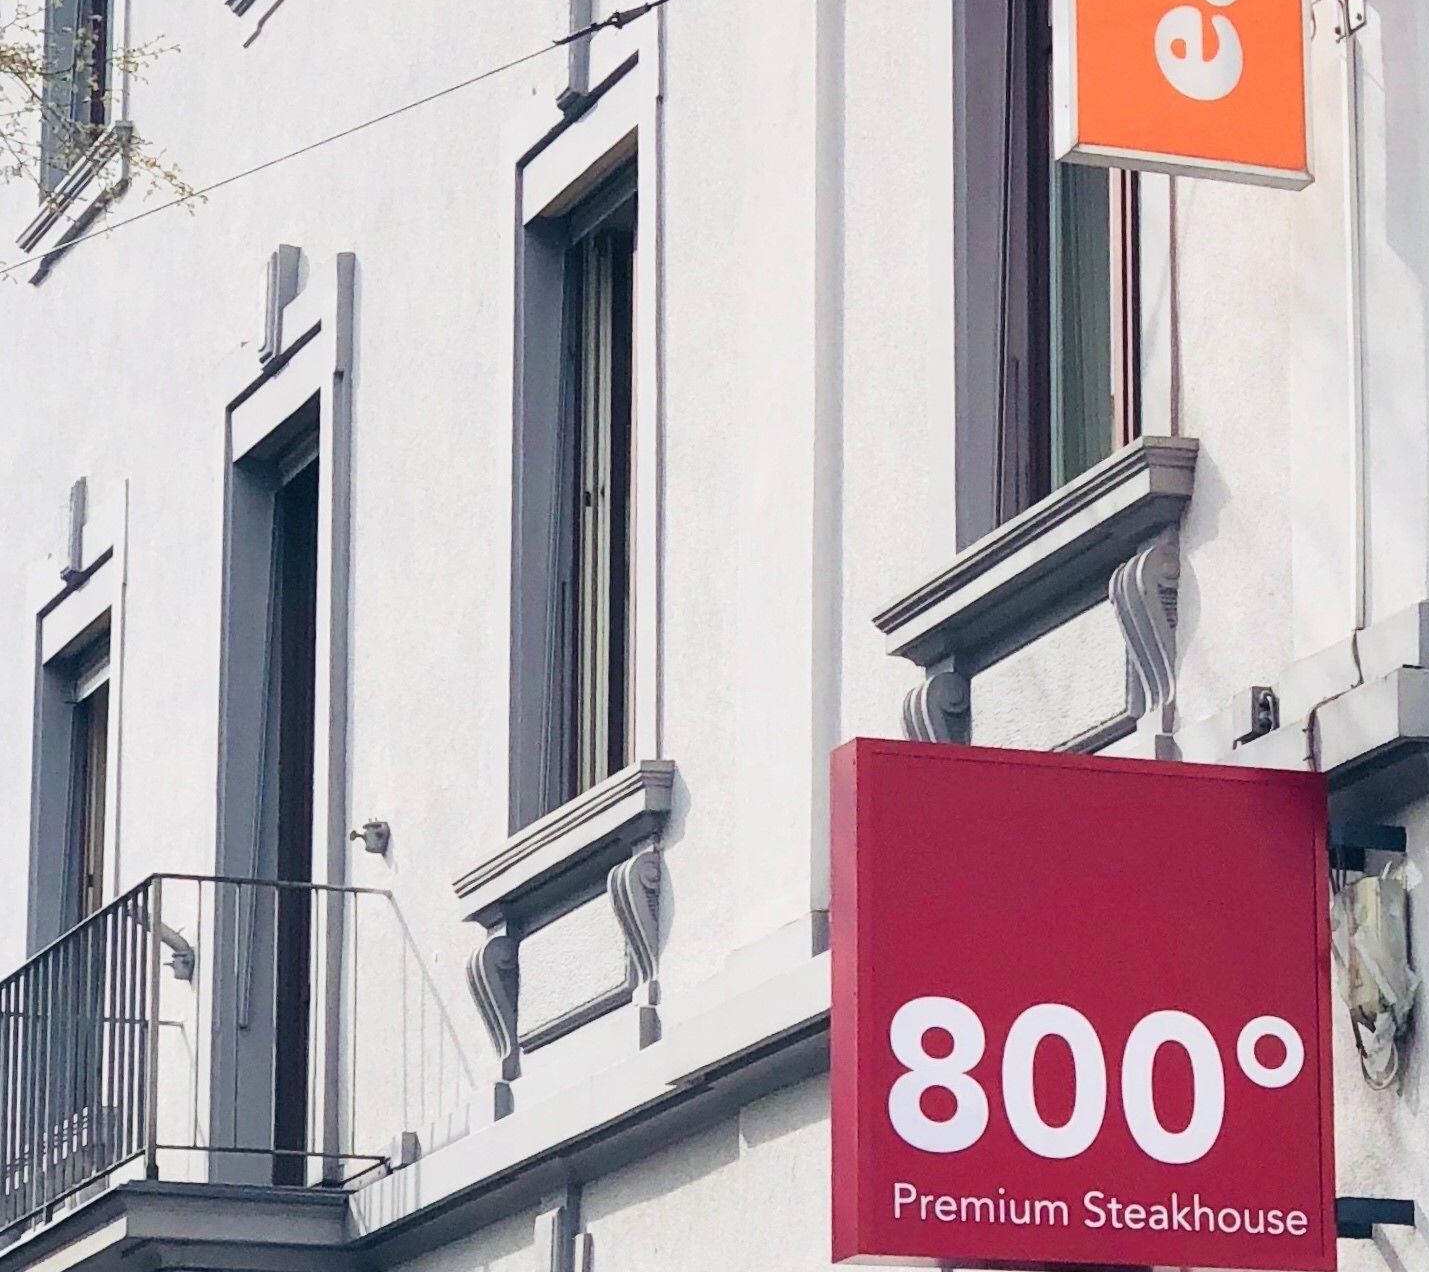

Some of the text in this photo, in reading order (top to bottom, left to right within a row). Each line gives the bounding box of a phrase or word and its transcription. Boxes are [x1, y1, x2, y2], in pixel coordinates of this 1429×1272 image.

[888, 995, 1305, 1164] 800°
[894, 1182, 1308, 1236] Premium Steakhouse
